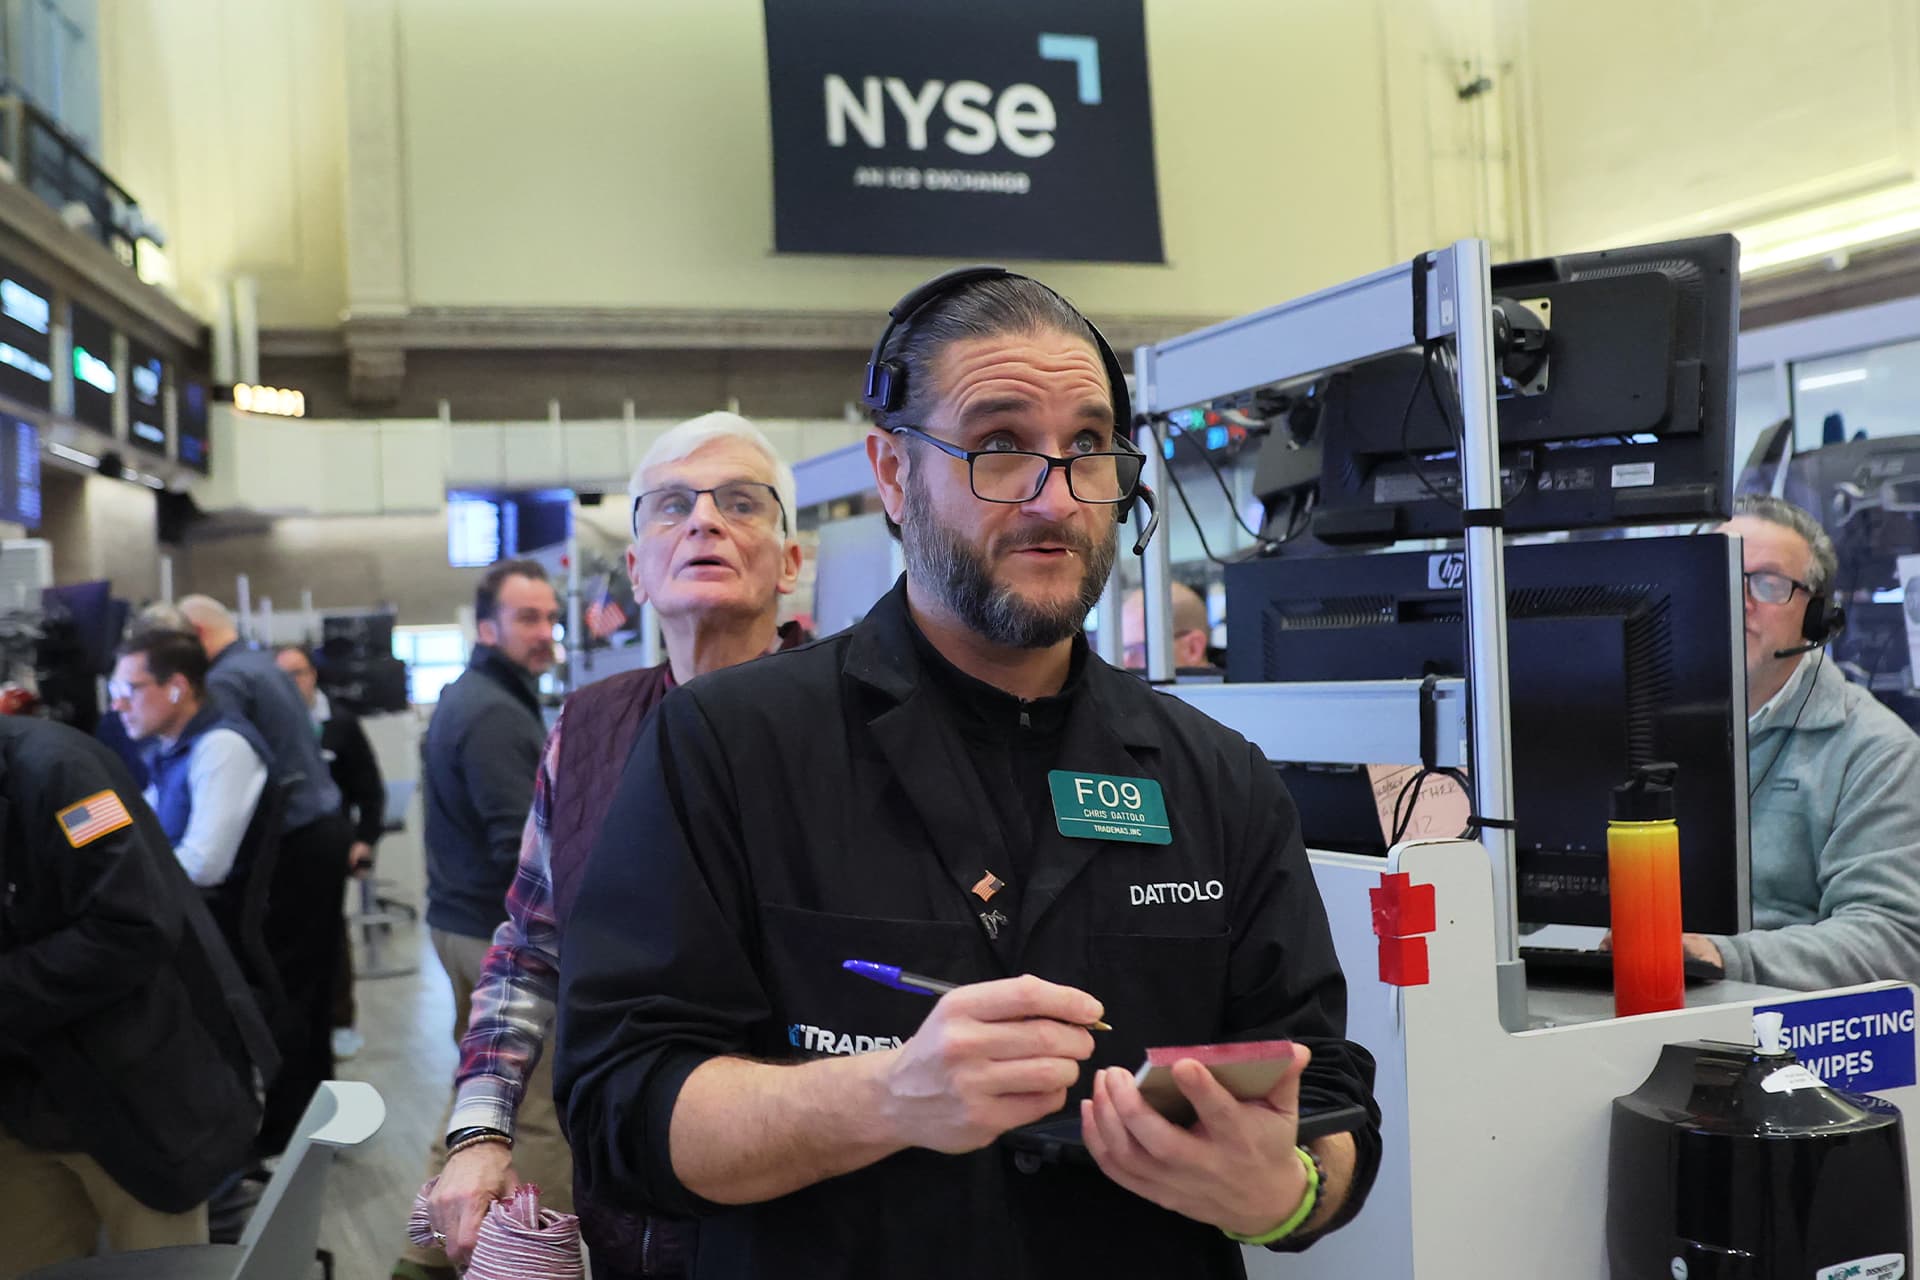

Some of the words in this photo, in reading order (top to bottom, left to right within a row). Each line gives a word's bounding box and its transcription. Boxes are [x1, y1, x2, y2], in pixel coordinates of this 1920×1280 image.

[1074, 778, 1142, 809] F09
[1083, 808, 1107, 819] CHRIS
[1110, 810, 1145, 822] DATTOLO
[1129, 880, 1224, 906] DATTOLO
[1756, 1009, 1916, 1051] SINFECTING
